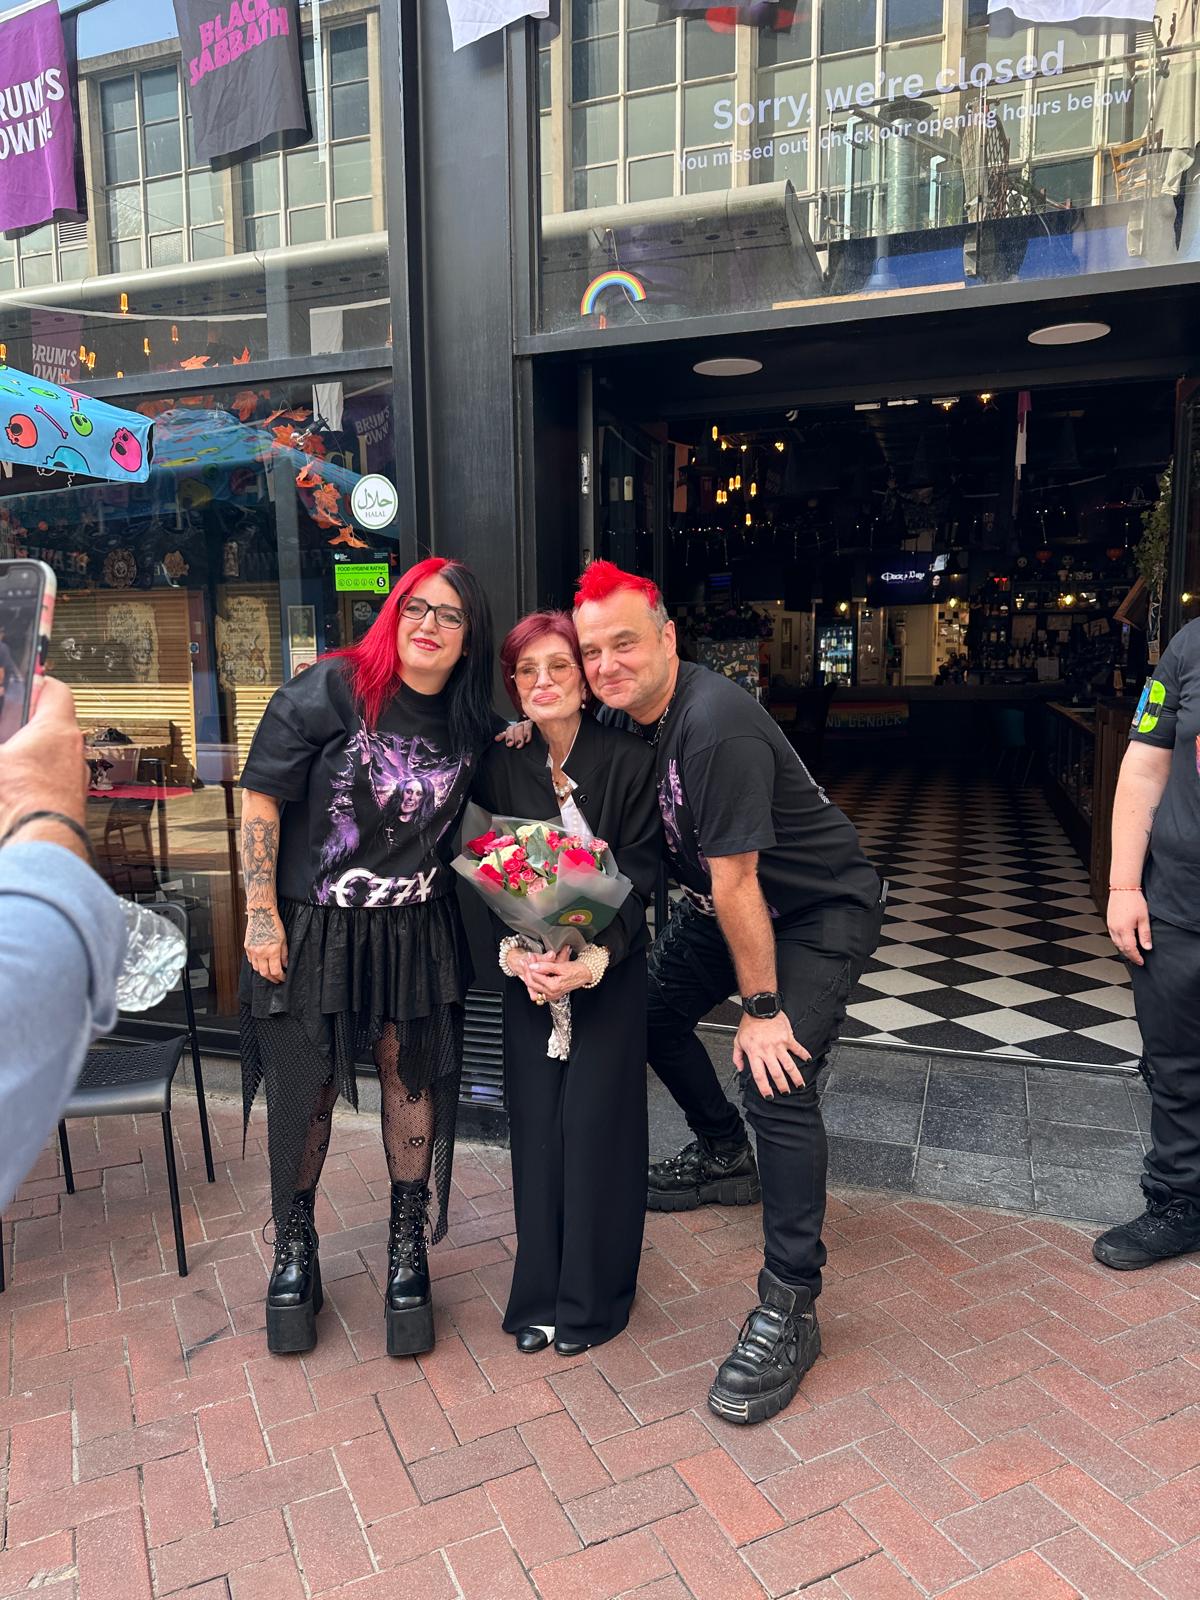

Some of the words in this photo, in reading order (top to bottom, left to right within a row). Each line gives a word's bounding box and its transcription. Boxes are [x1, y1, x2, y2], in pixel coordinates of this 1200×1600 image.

[189, 7, 289, 87] SABBATH
[199, 0, 269, 49] BLACK
[713, 92, 814, 130] Sorry,
[936, 40, 1065, 94] closed
[678, 153, 708, 172] You
[713, 146, 774, 167] missed
[820, 127, 874, 149] check
[880, 122, 912, 140] our
[917, 108, 997, 136] opening
[1003, 99, 1061, 122] hours
[1067, 88, 1132, 112] below
[358, 488, 393, 510] حلال
[365, 510, 386, 518] HALAL
[328, 867, 438, 908] OZZY
